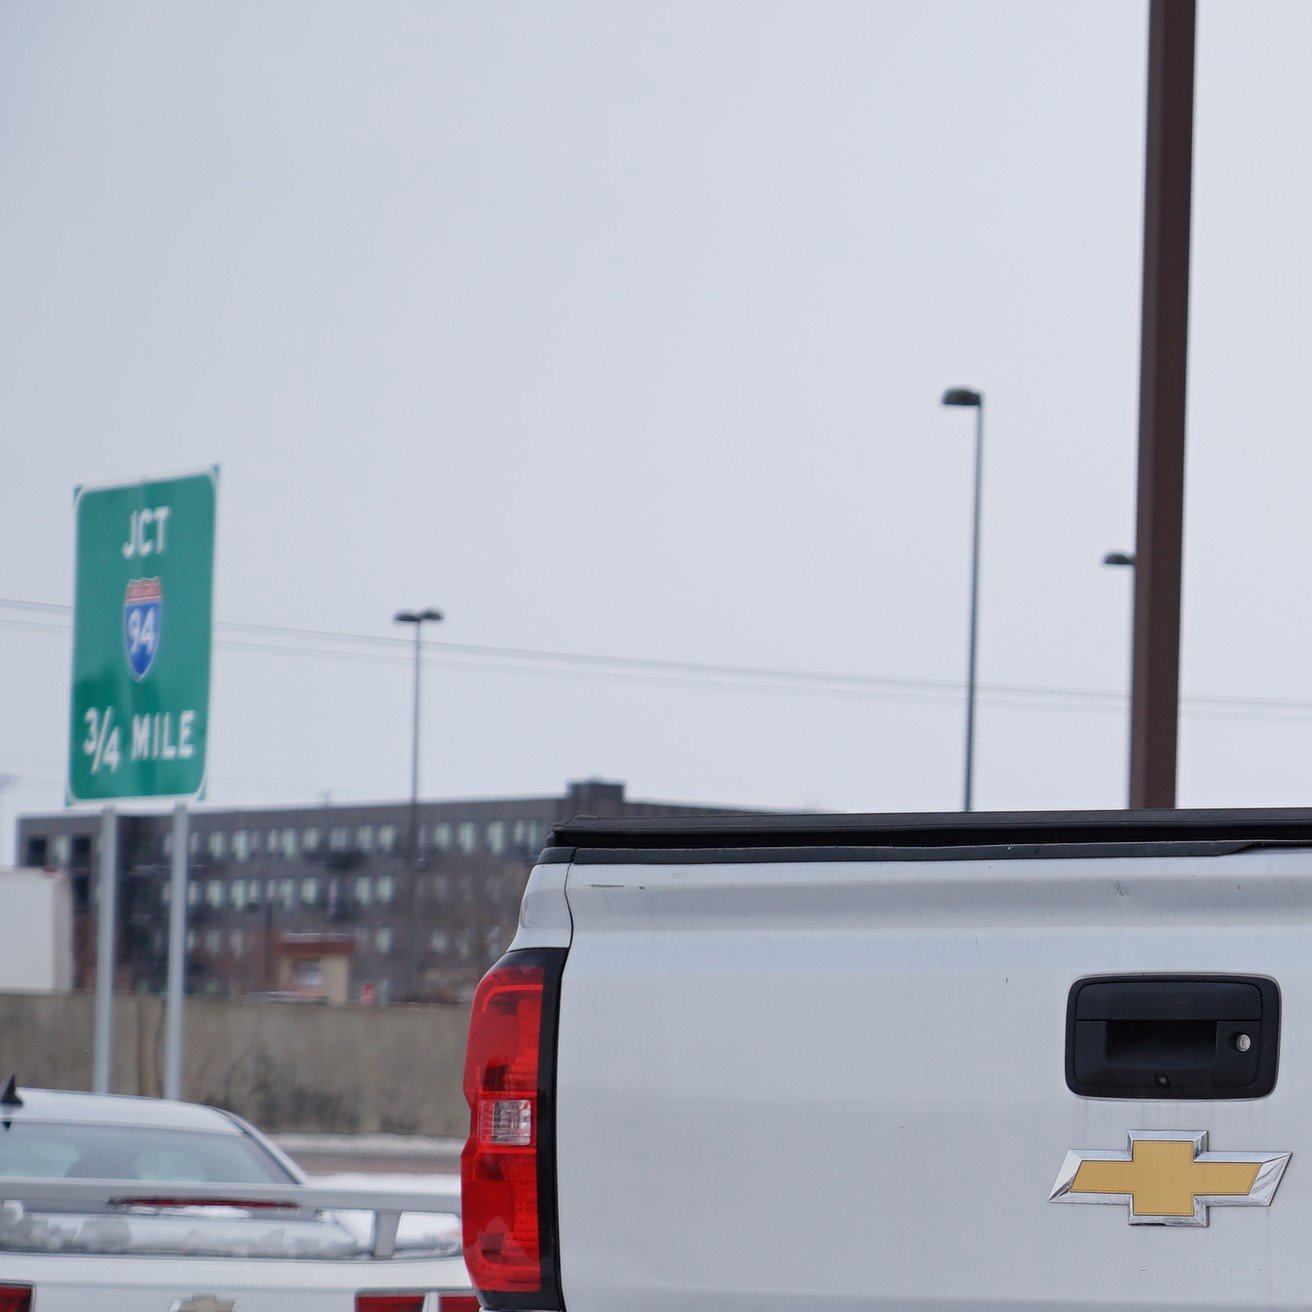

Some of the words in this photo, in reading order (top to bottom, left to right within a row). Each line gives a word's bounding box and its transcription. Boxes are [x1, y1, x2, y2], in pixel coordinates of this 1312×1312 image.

[121, 506, 170, 559] JCT
[127, 606, 156, 654] 94
[130, 709, 197, 761] MILE
